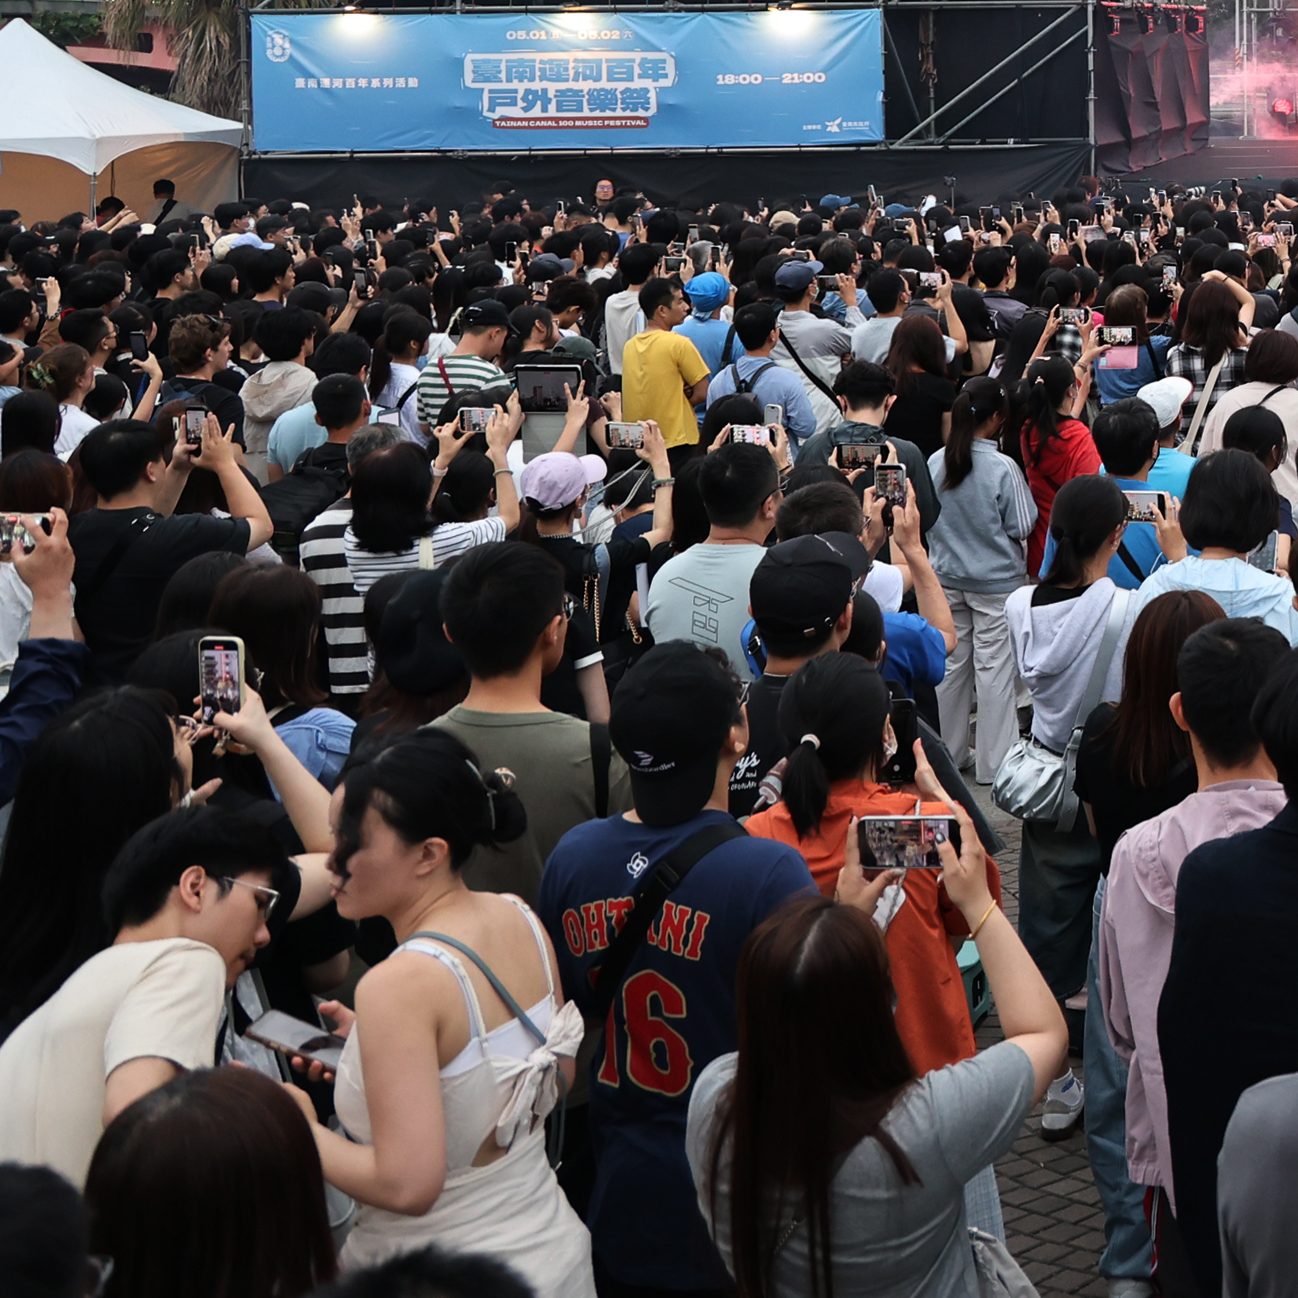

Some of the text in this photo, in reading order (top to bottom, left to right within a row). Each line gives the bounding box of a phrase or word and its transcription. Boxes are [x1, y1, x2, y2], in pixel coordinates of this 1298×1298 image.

[506, 30, 548, 40] 05.01
[577, 29, 621, 40] 05.02
[471, 57, 669, 84] 臺南運河百年
[294, 77, 420, 89] 臺南運河百年系列活動
[716, 73, 763, 85] 18:00
[781, 72, 827, 84] 21:00
[486, 86, 652, 114] 戶外音樂祭
[604, 119, 647, 127] FESTIVAL
[562, 896, 710, 961] OHTNI
